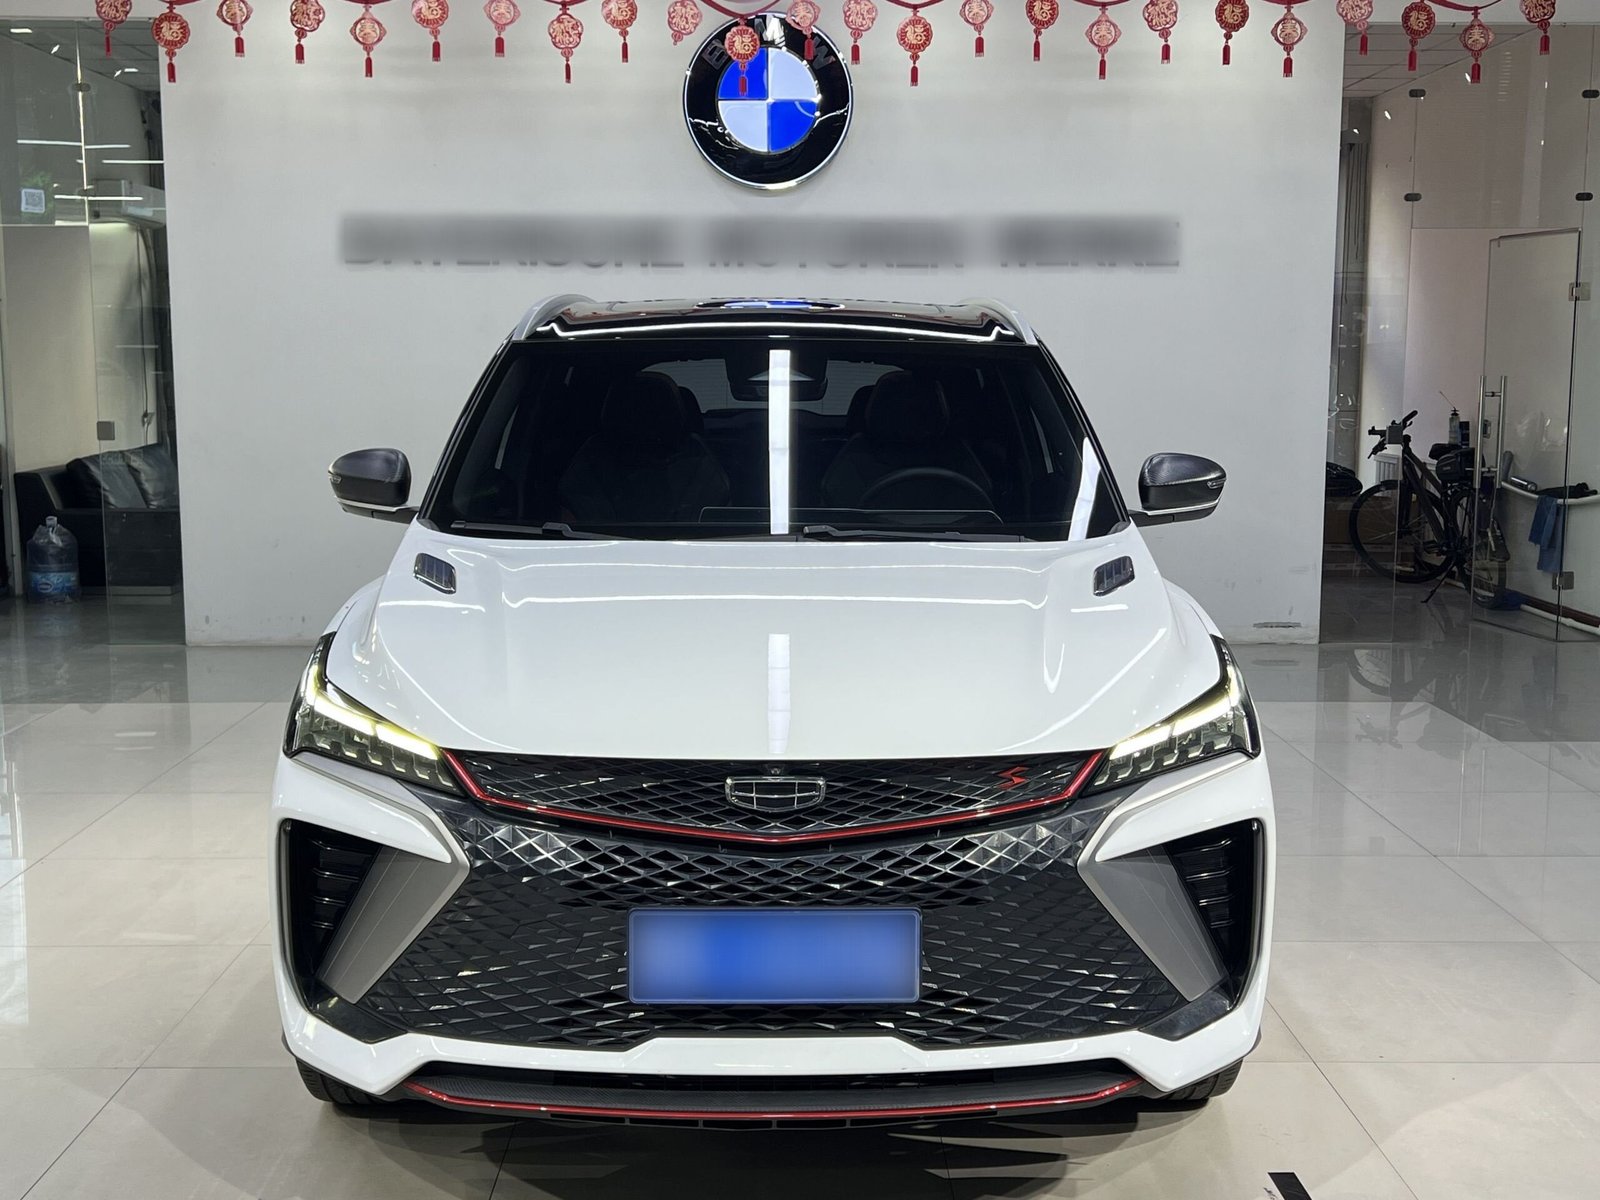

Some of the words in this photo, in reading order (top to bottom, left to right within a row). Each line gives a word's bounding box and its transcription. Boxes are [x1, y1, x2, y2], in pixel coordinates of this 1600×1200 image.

[1224, 3, 1241, 23] 福
[1410, 12, 1428, 31] 福
[160, 21, 183, 41] 福
[905, 25, 926, 43] 福
[701, 15, 836, 71] BMW
[734, 35, 753, 54] 福
